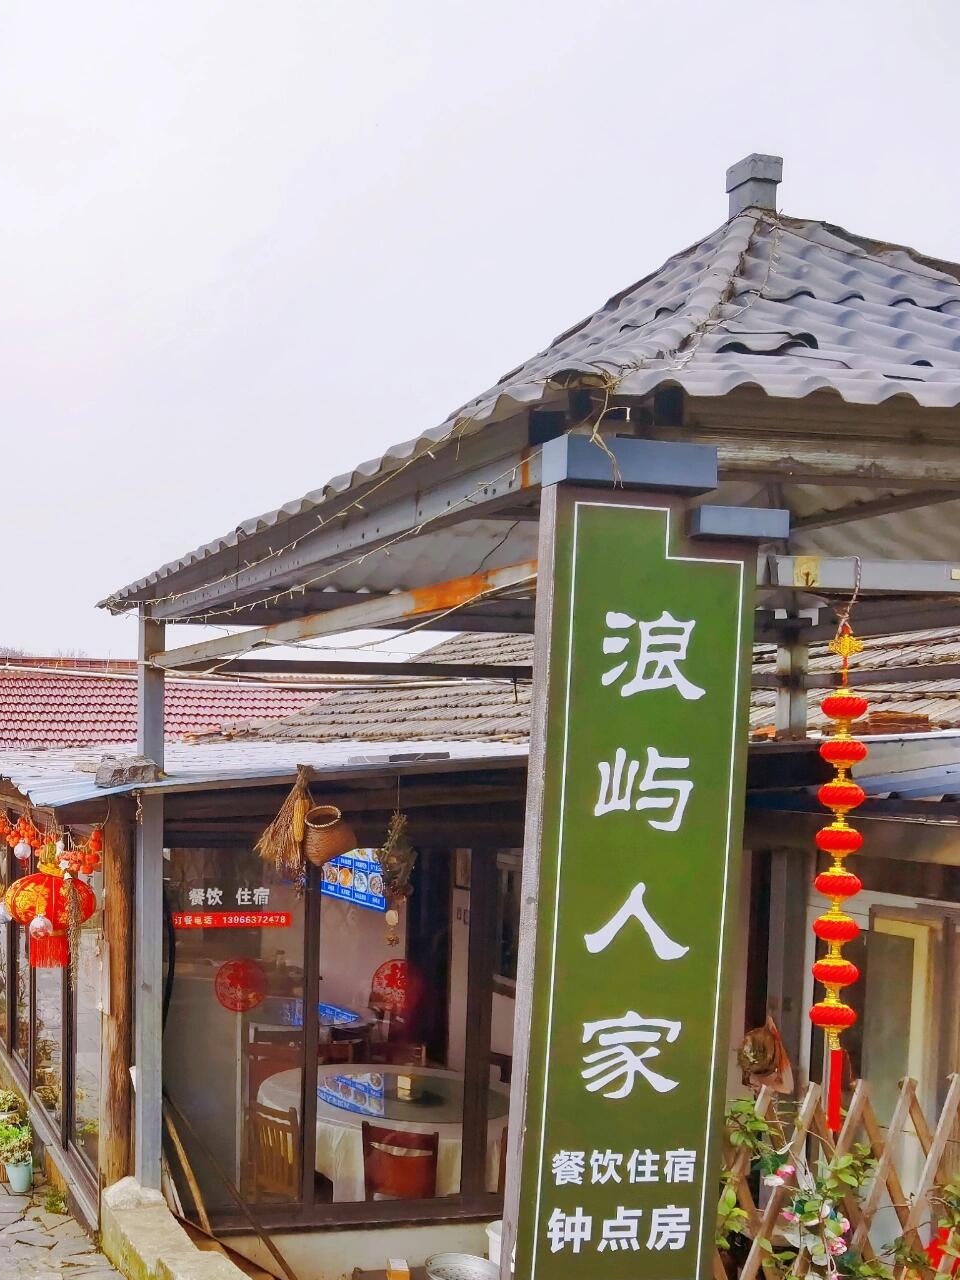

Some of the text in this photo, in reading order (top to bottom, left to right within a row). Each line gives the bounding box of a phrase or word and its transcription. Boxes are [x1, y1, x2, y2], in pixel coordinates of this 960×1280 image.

[581, 610, 707, 1100] 浪屿人家
[188, 887, 270, 906] 餐饮 住宿
[551, 1148, 697, 1186] 餐饮住宿
[547, 1204, 691, 1254] 钟点房
